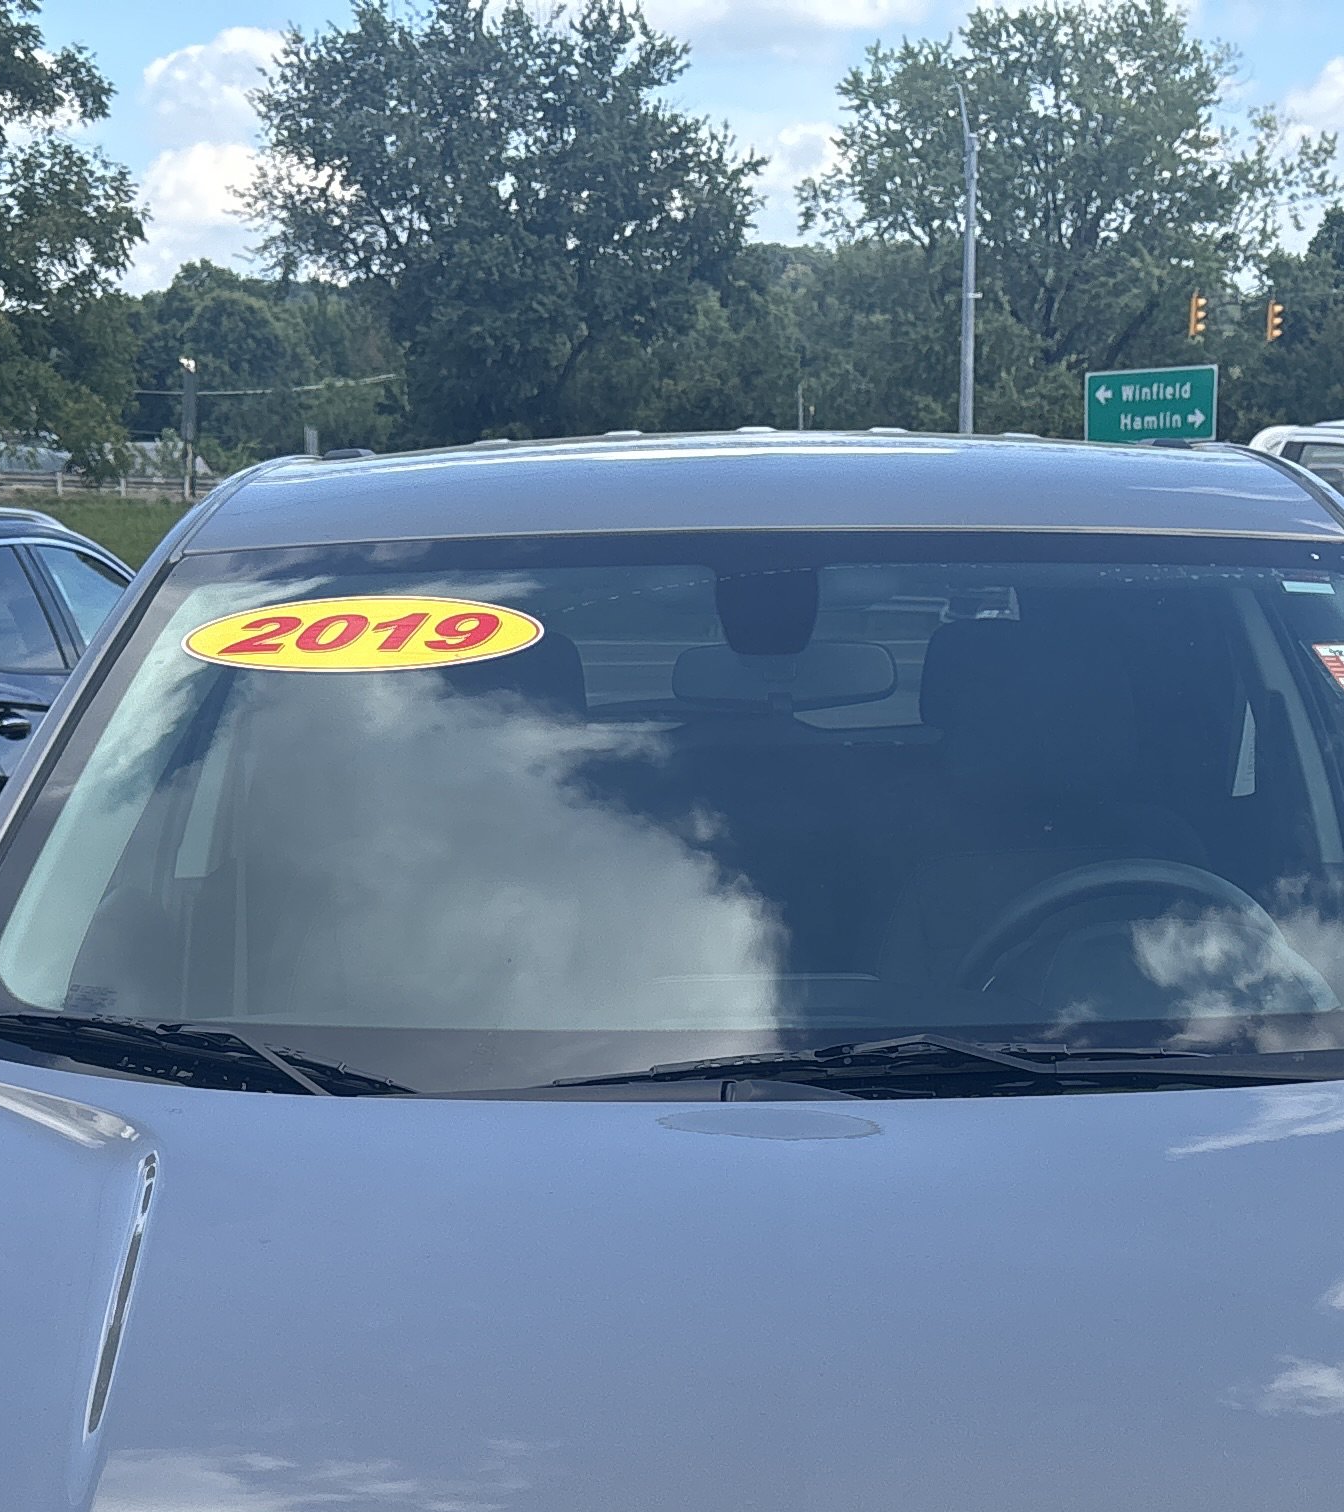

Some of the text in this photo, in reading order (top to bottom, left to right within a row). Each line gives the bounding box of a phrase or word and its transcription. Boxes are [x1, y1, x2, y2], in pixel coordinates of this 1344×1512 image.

[1121, 382, 1191, 401] Winfield
[1119, 411, 1182, 431] Hamlin
[216, 612, 504, 656] 2019
